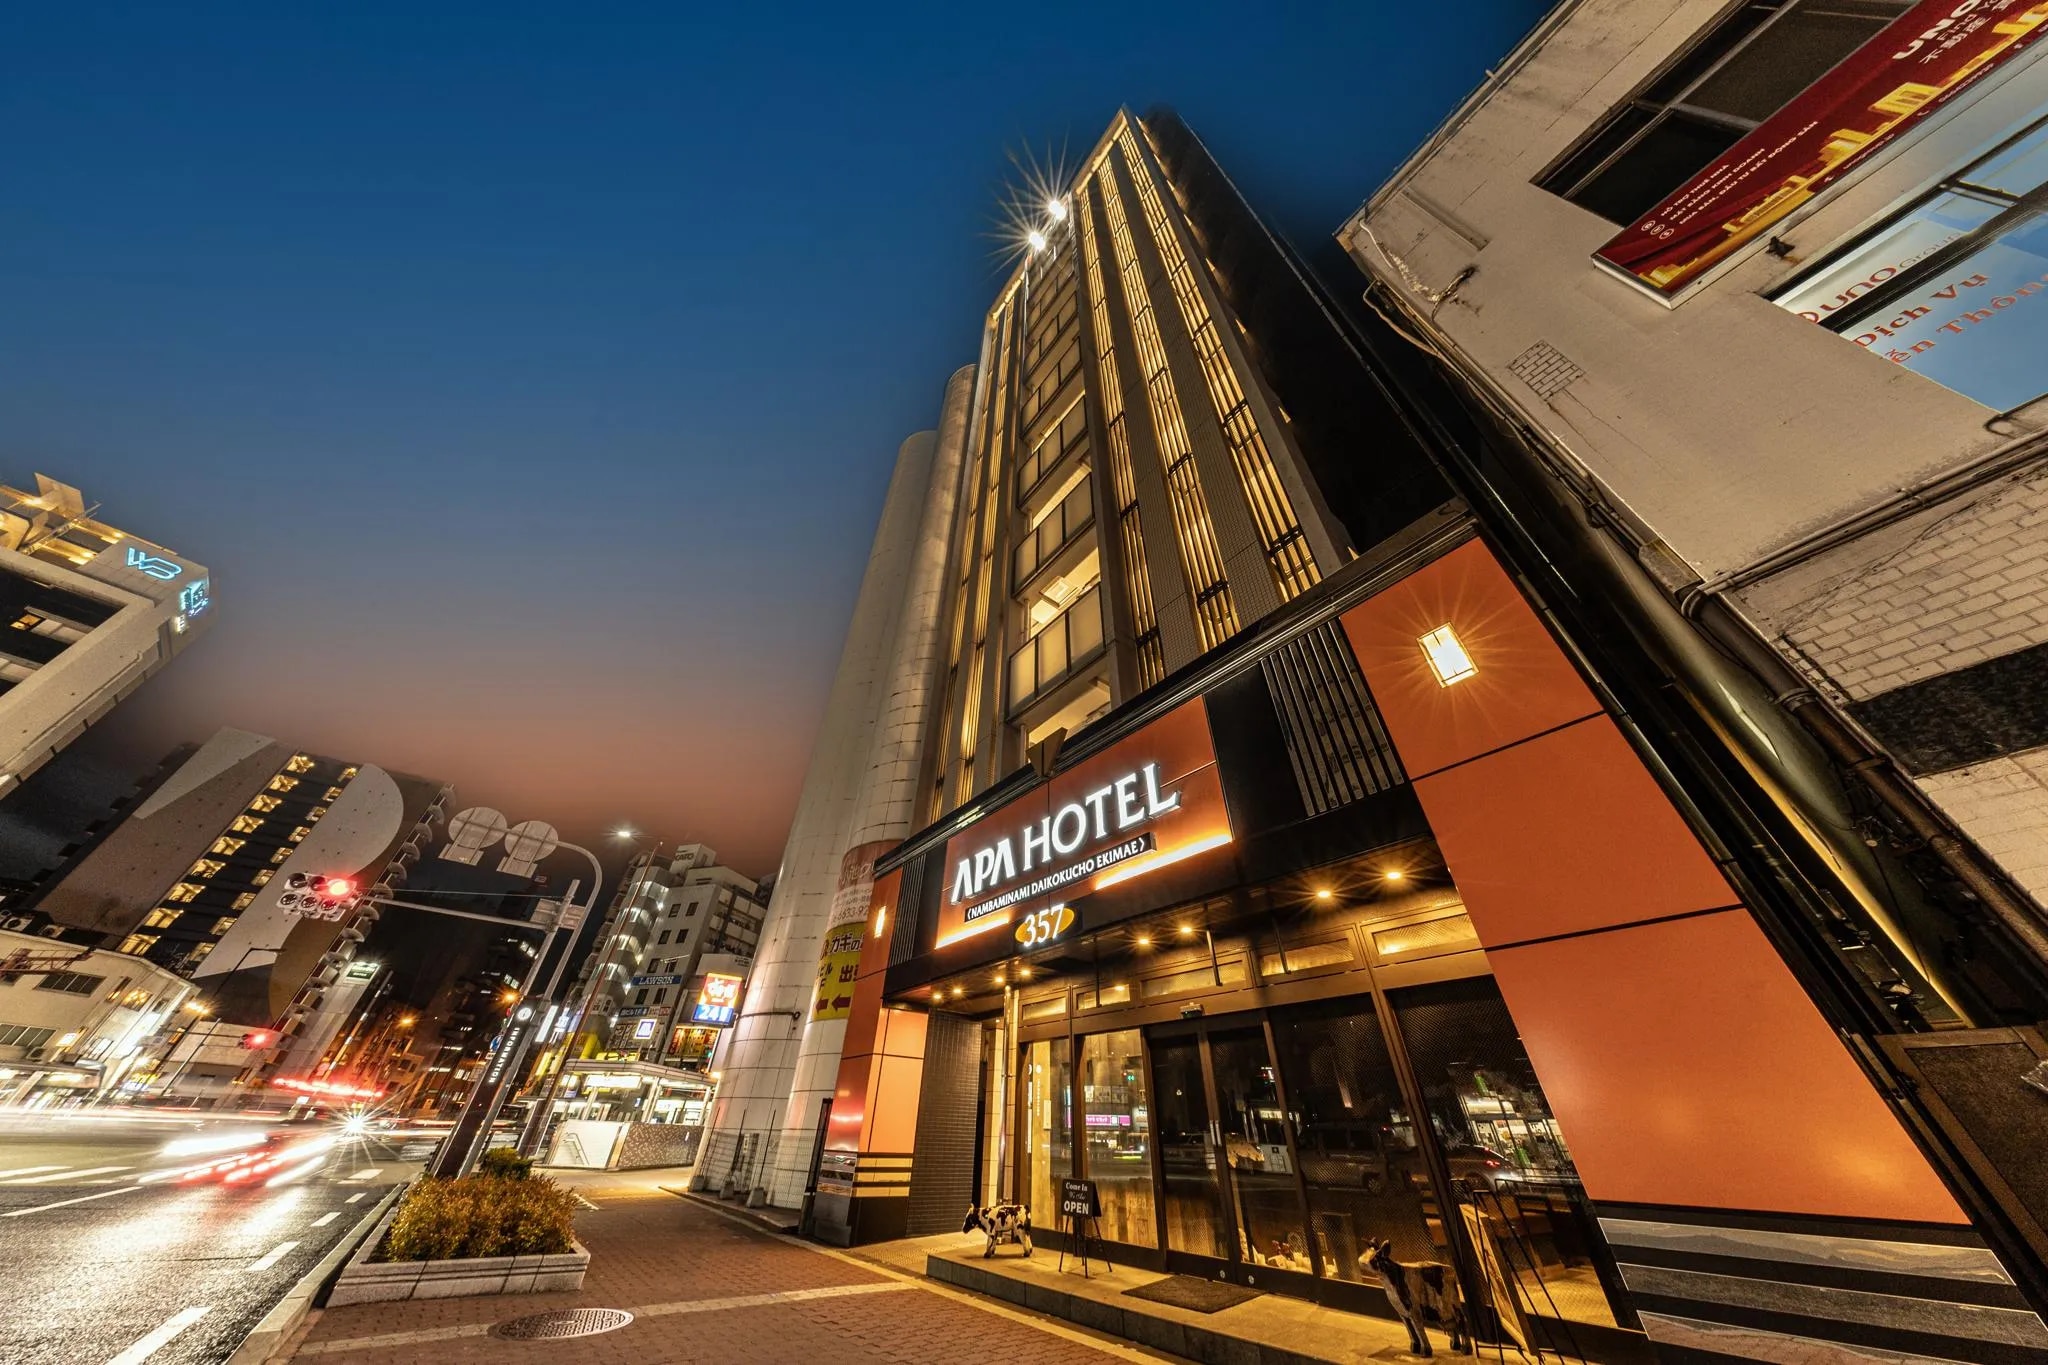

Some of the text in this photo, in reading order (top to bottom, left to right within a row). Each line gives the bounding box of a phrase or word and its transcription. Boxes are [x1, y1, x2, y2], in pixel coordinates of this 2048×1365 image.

[1892, 0, 1983, 59] UNO
[1936, 13, 1977, 41] Find
[1852, 272, 1990, 349] Dịch Vụ
[951, 761, 1182, 904] APA HOTEL
[1031, 859, 1095, 895] DAIKOKUCHO
[1023, 903, 1066, 947] 357
[638, 976, 675, 985] LAWSON
[488, 1027, 520, 1083] INFORMATION
[1065, 1182, 1088, 1192] Come In
[1063, 1200, 1089, 1215] OPEN
